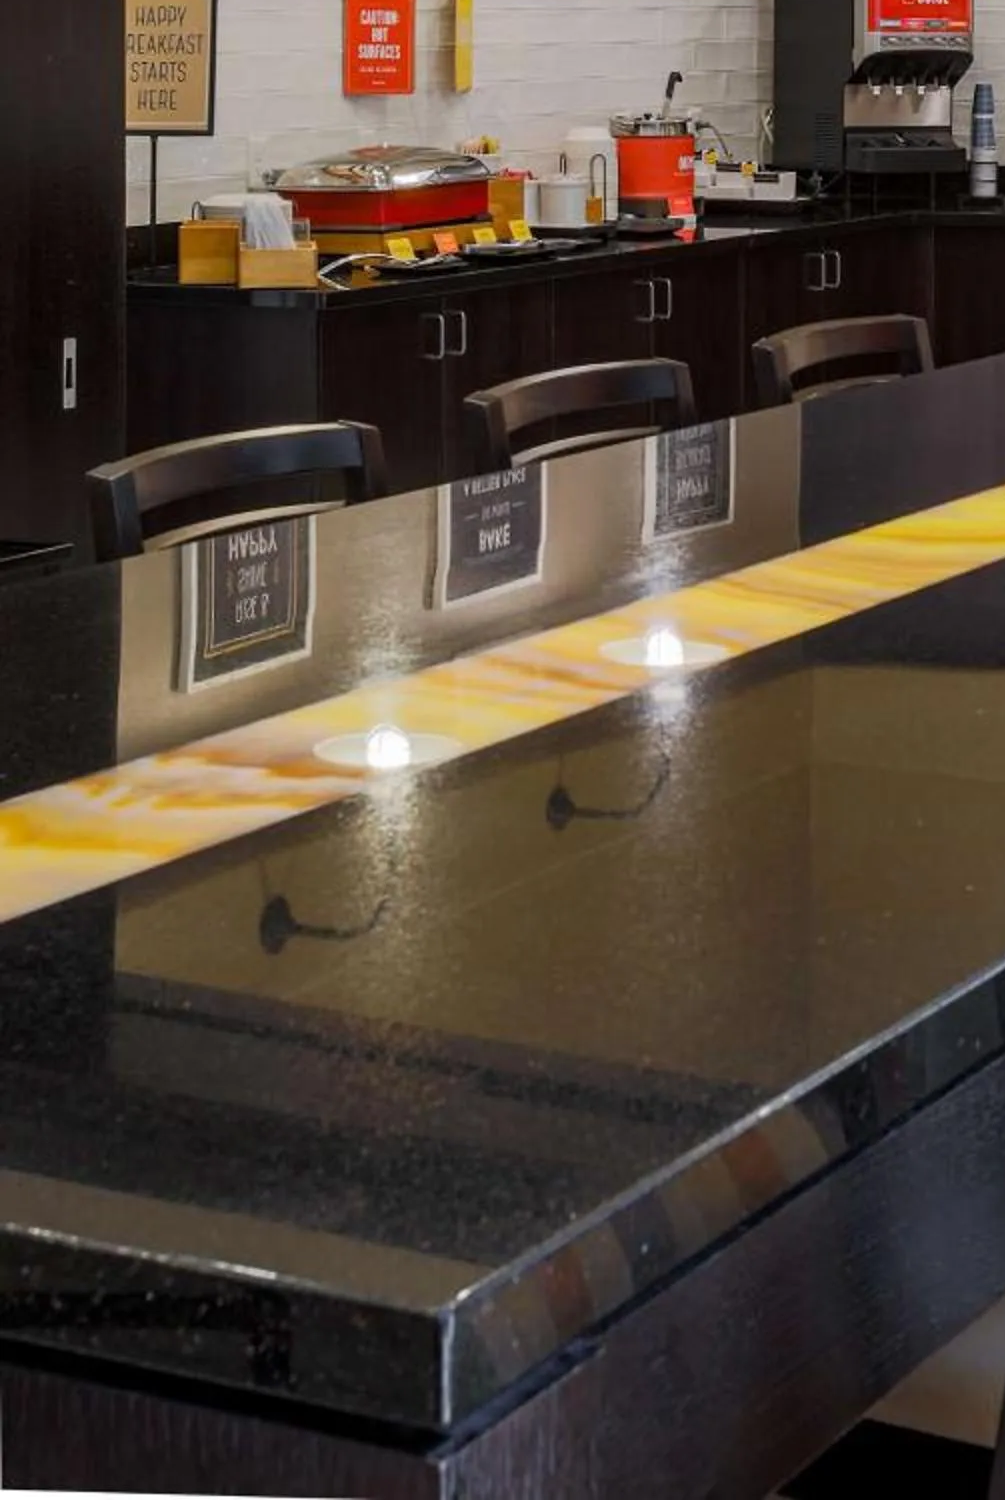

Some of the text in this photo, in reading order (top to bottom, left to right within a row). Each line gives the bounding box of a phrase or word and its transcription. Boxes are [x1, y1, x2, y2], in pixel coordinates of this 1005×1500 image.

[135, 4, 187, 27] HAPPY
[126, 33, 204, 55] REAKFAST
[371, 27, 389, 43] HOT
[358, 43, 401, 60] SURFACES
[131, 61, 187, 83] STARTS
[137, 89, 178, 111] HERE
